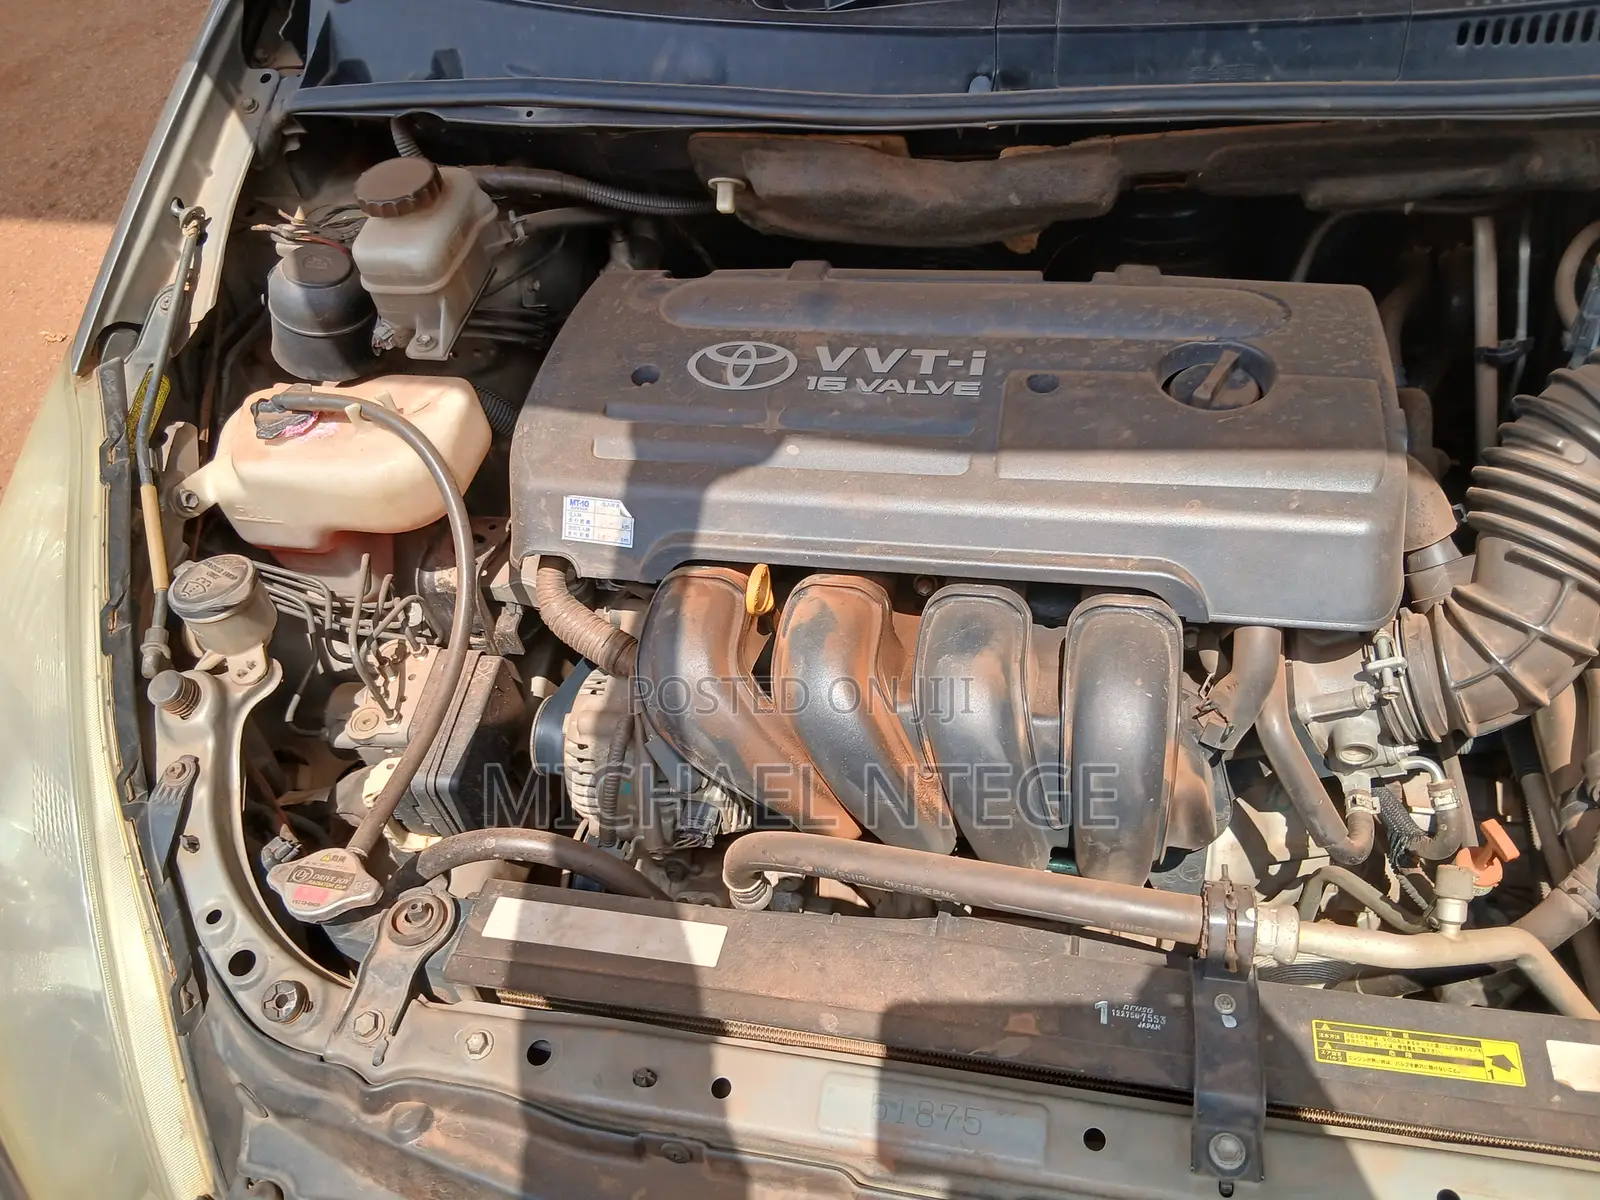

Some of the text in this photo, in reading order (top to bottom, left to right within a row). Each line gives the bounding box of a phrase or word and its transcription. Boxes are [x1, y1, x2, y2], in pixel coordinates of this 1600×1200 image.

[815, 346, 987, 375] VVT-i
[806, 376, 982, 396] 16 VALVE
[1094, 1001, 1108, 1025] 1
[1138, 1022, 1161, 1030] JAPAN
